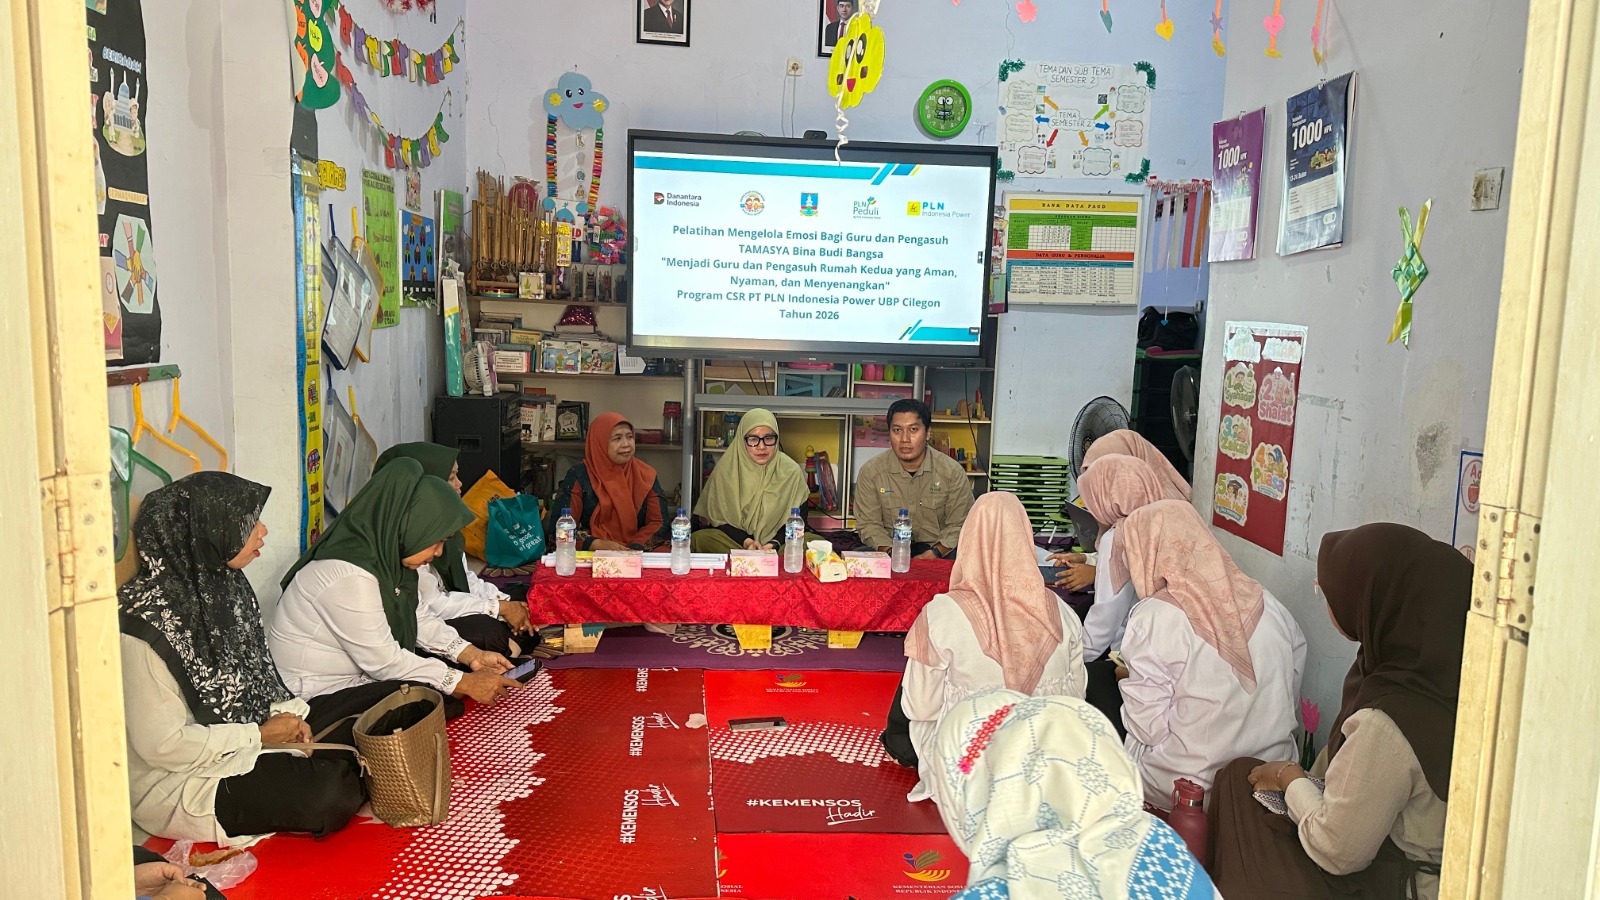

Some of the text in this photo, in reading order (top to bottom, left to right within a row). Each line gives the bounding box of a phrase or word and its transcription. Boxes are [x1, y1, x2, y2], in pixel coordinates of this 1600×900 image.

[1039, 64, 1111, 76] TEMA DAN SUB TEMA
[1050, 75, 1096, 84] SEMESTER 2
[1059, 111, 1077, 119] TEMA
[1051, 119, 1093, 128] SEMESTER 2
[1292, 118, 1323, 151] 1000
[1218, 145, 1240, 170] 1000
[666, 192, 702, 201] Danantara
[666, 199, 700, 207] Indonesia
[853, 207, 879, 216] Peduli
[922, 201, 945, 210] PLN
[922, 210, 951, 218] Indonesia
[673, 225, 949, 246] Pelatihan Mengelola Emosi Bagi Guru dan Pengasuh
[739, 244, 884, 261] TAMASYA Bina Budi Bangsa
[661, 257, 958, 278] "Menjadi Guru dan Pengasuh Rumah Kedua yang Aman,
[730, 275, 890, 291] Nyaman, dan Menyenangkan"
[677, 289, 941, 309] Program CSR PT PLN Indonesia Power UBP Cilegon
[779, 309, 840, 320] Tahun 2026
[1226, 389, 1255, 402] Syahadat
[1259, 401, 1292, 422] Shalat
[1220, 436, 1250, 456] Zakat
[1253, 467, 1285, 494] Puasa
[636, 668, 649, 693] #KEMENS
[628, 715, 645, 757] #KEMENSOS
[640, 783, 671, 807] Hadir
[745, 798, 862, 807] #KEMENSOS
[619, 789, 640, 844] #KEMENSOS
[825, 806, 876, 822] Hadir
